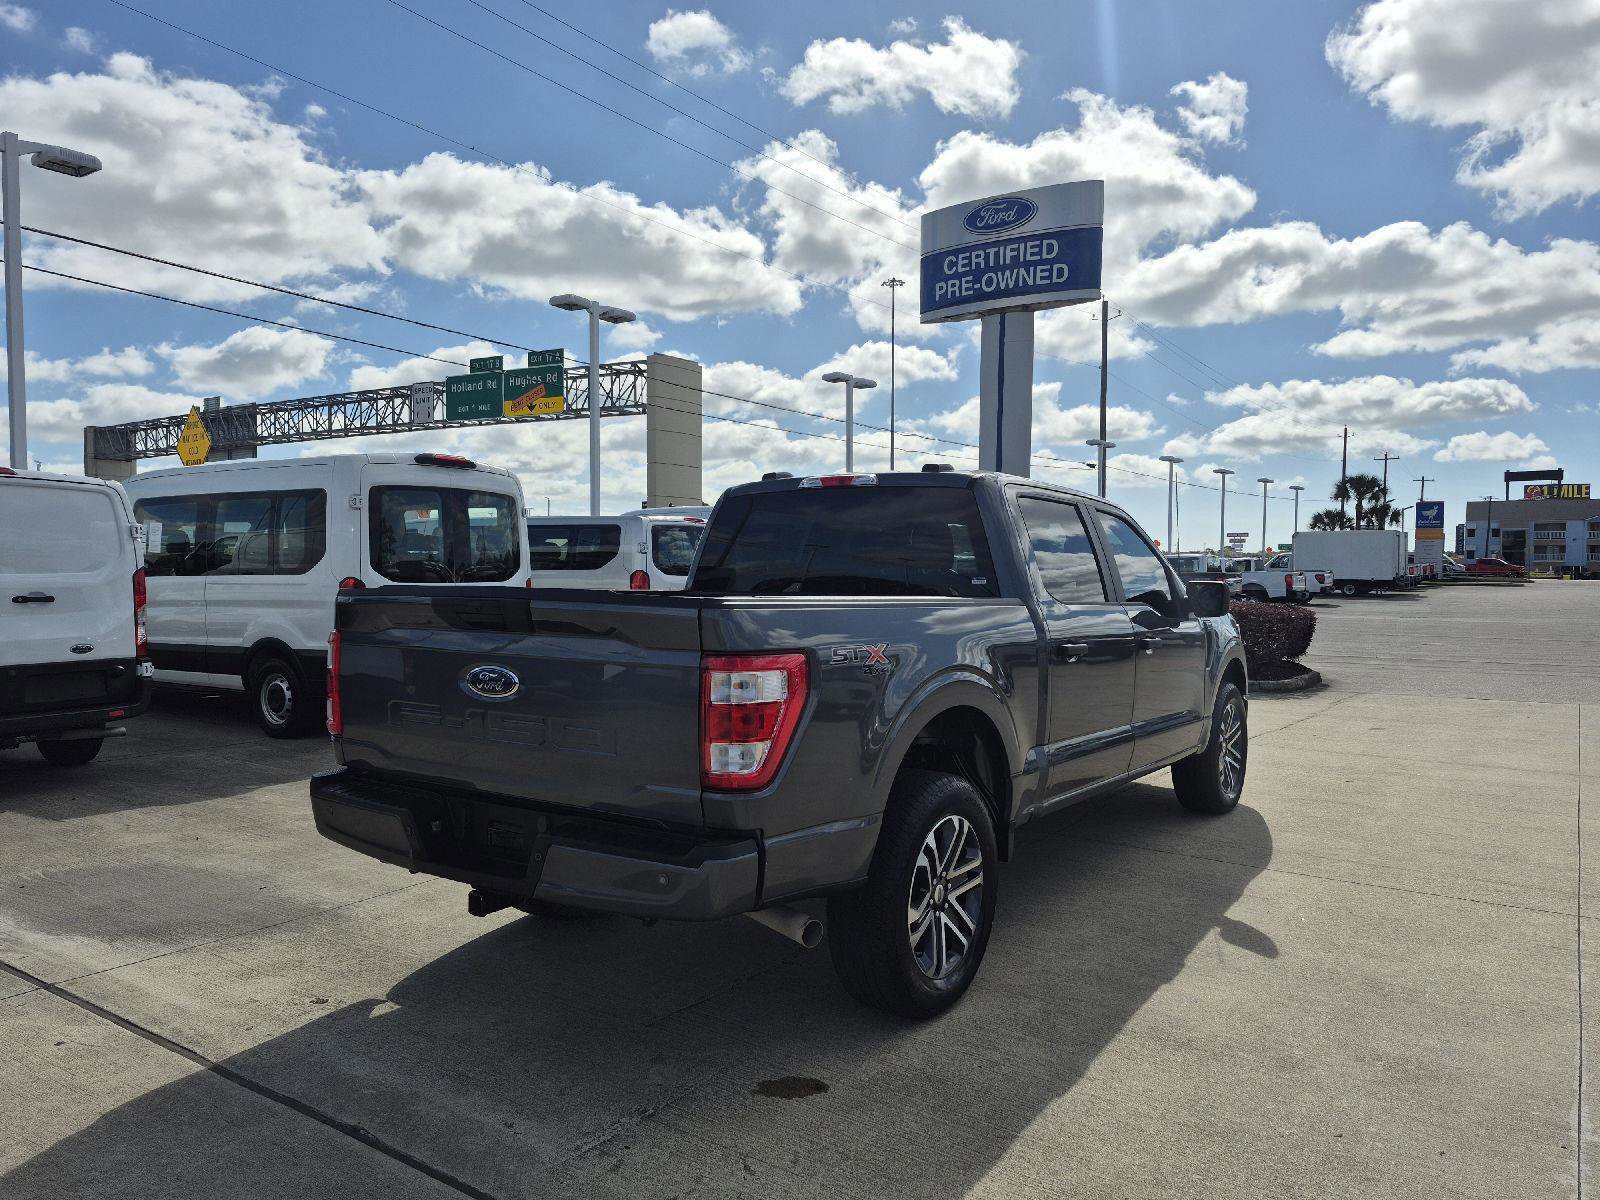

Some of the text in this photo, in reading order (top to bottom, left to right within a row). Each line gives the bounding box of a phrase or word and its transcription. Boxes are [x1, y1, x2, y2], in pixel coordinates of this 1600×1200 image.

[977, 203, 1018, 227] Ford
[943, 239, 1059, 275] CERTIFIED
[935, 263, 1069, 301] PRE-OWNED
[451, 378, 498, 393] Holland Rd
[509, 372, 558, 387] Hughes Rd
[414, 386, 433, 395] SPEED
[415, 396, 431, 405] LIMIT
[538, 402, 556, 410] ONLY
[1553, 485, 1590, 498] MILE
[829, 642, 891, 665] STX
[476, 671, 505, 691] Ford
